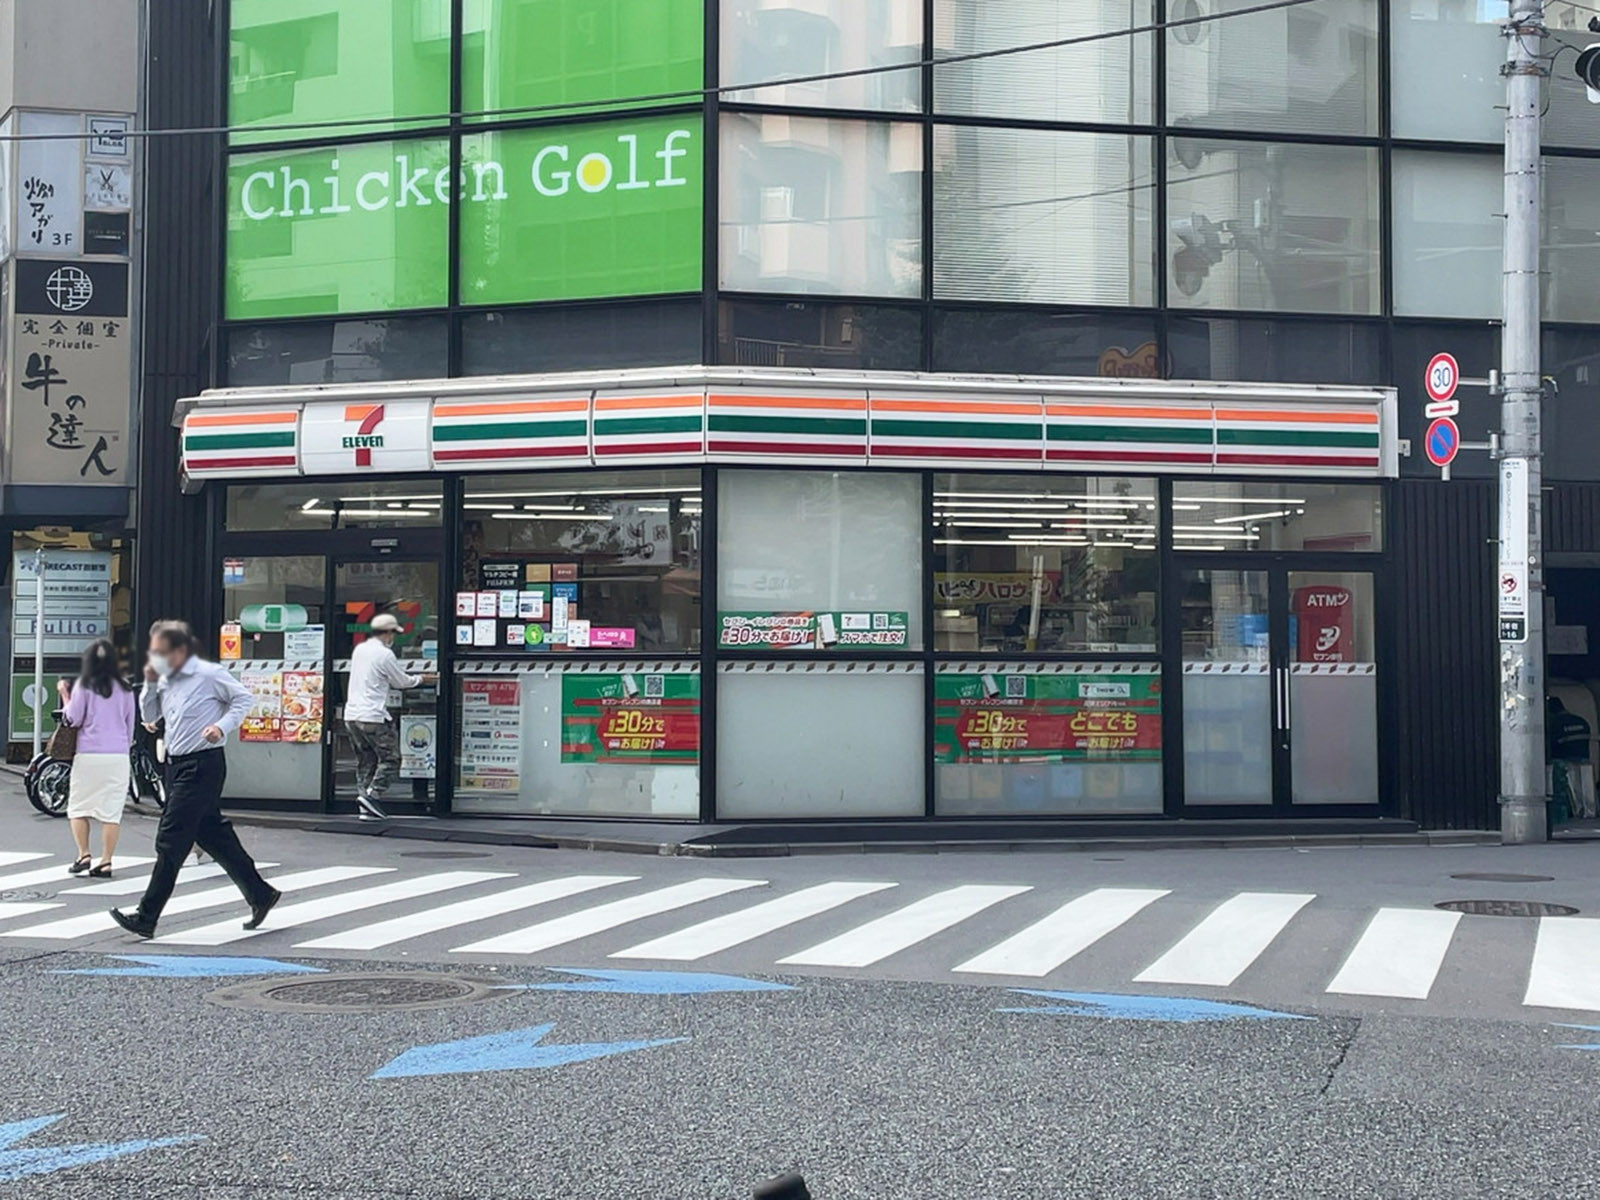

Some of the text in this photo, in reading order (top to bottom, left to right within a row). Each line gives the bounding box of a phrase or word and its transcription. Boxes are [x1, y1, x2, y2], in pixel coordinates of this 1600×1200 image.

[241, 130, 691, 221] Chicken Golf
[52, 232, 73, 246] 3F
[21, 319, 121, 338] 完全個室
[1433, 367, 1451, 388] 30
[21, 352, 117, 477] 牛の達人
[344, 403, 384, 467] 7
[1307, 594, 1338, 607] ATM
[1070, 711, 1137, 731] どこでも
